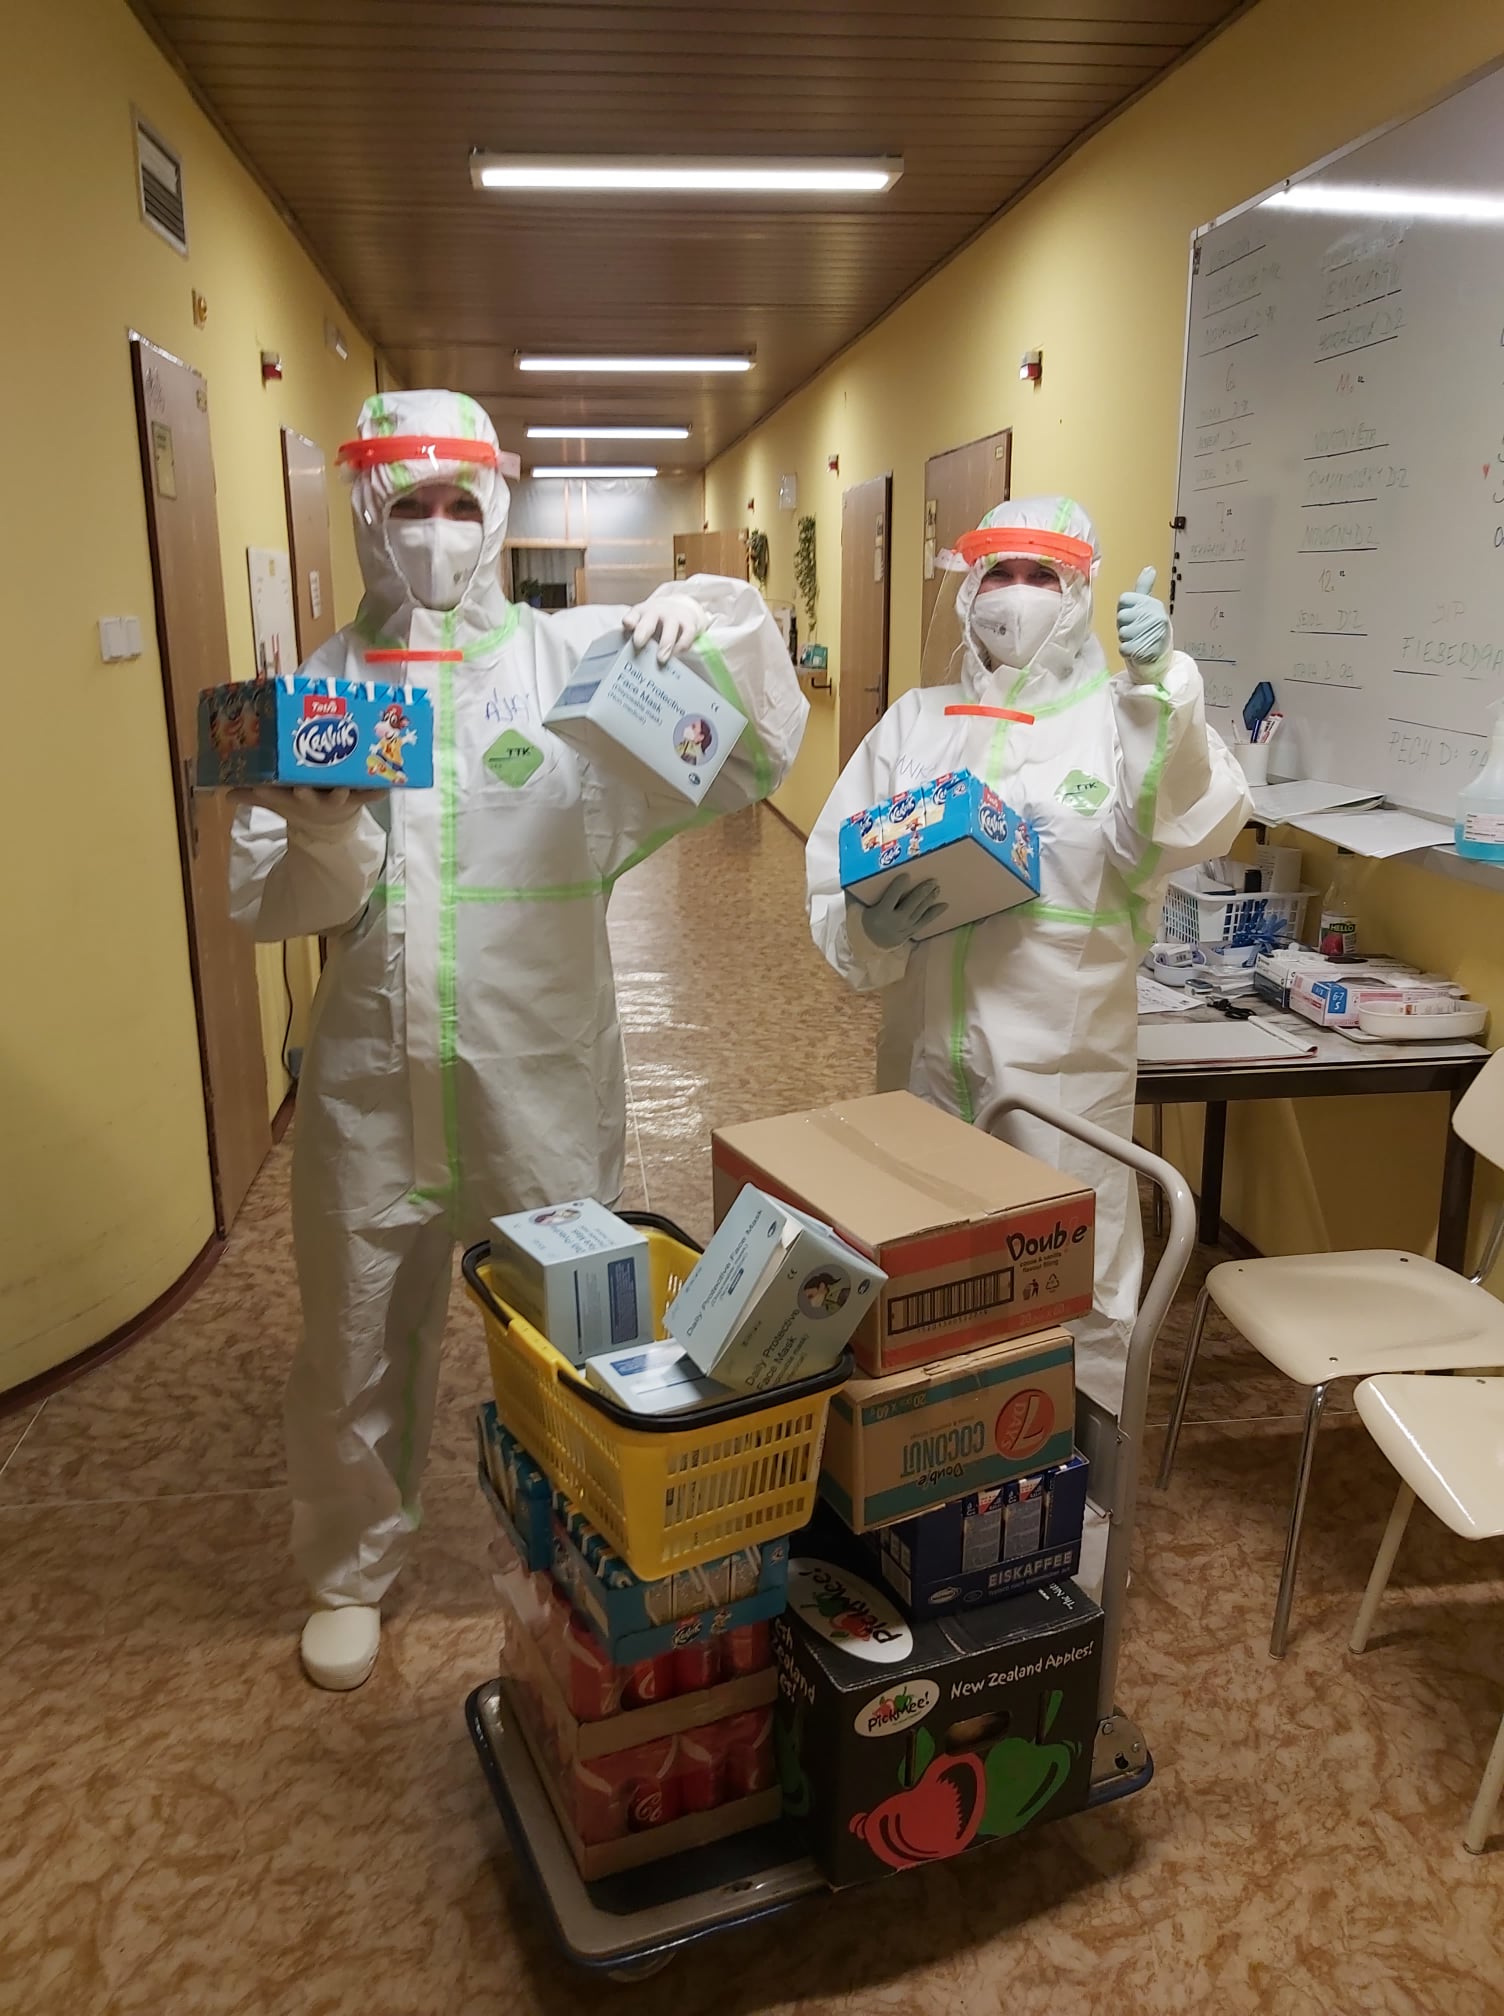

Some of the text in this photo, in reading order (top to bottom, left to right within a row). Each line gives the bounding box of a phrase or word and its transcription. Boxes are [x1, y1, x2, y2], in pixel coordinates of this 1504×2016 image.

[617, 673, 640, 700] Face
[640, 687, 662, 713] Mask
[624, 660, 646, 687] Daily
[646, 678, 686, 717] Protective
[1330, 924, 1354, 932] HELLO
[745, 1356, 766, 1387] Daily
[763, 1308, 800, 1358] Protective
[777, 1334, 797, 1363] Mask
[900, 1420, 986, 1479] COCONUT
[987, 1550, 1074, 1589] EISKAFFEE
[950, 1639, 1096, 1701] New Zealand Apples!
